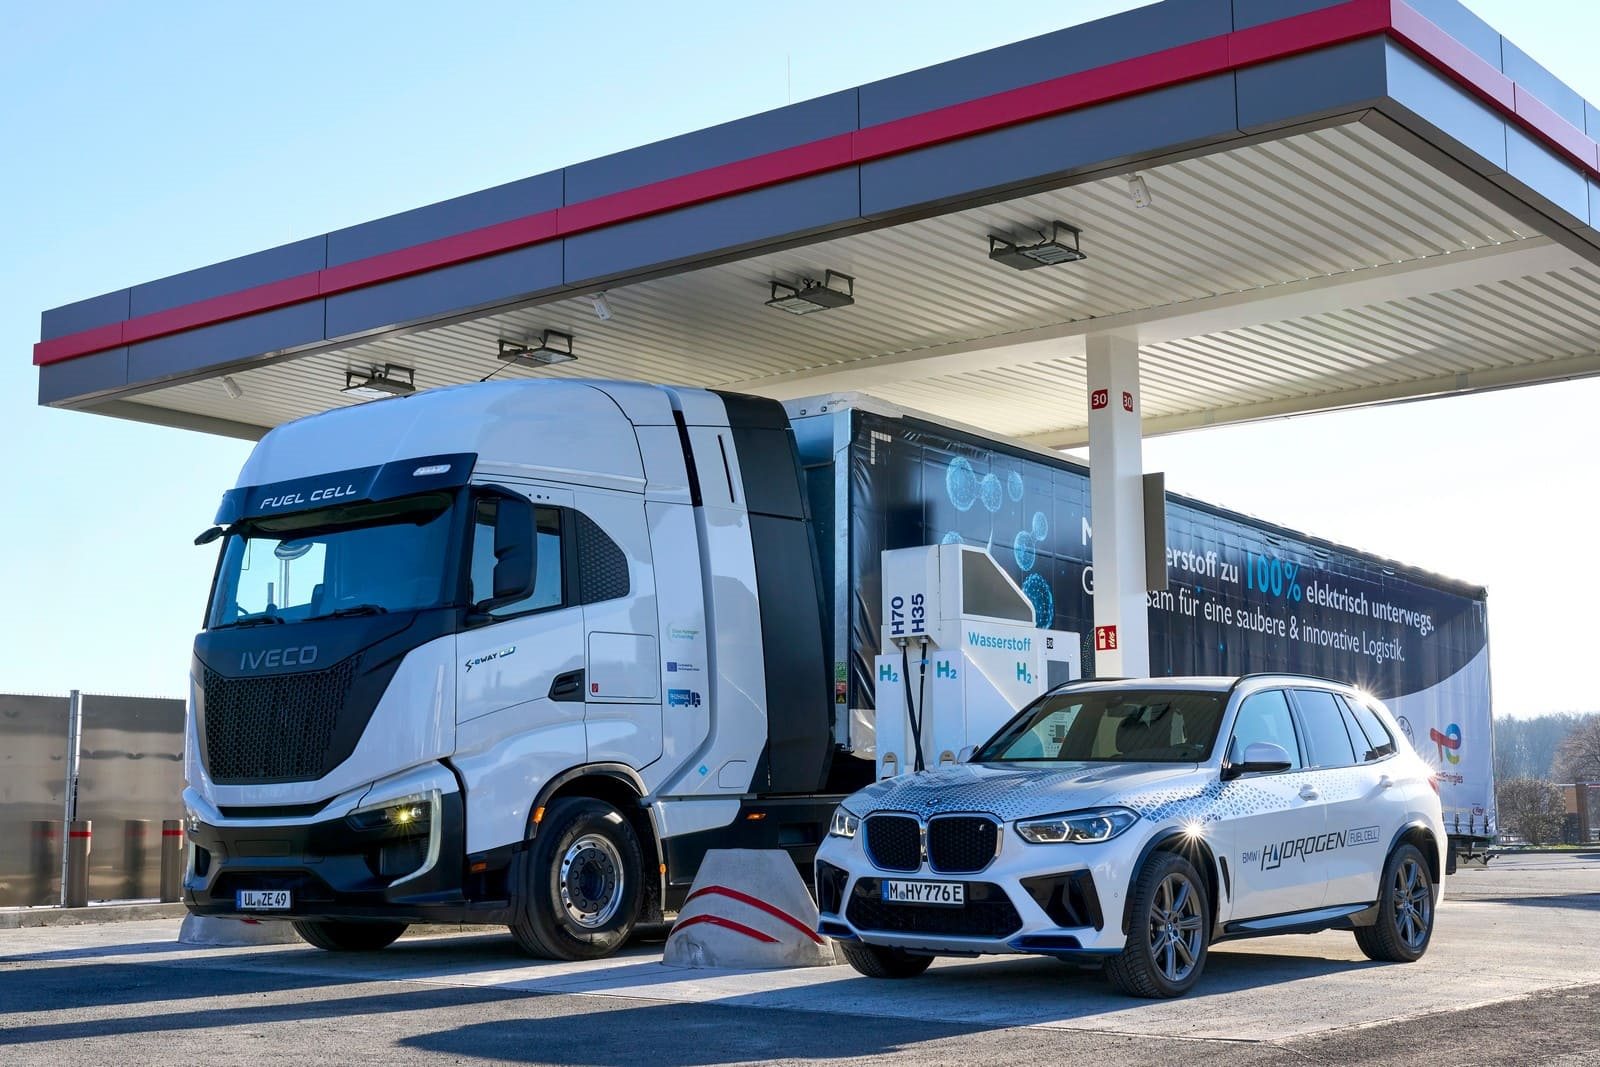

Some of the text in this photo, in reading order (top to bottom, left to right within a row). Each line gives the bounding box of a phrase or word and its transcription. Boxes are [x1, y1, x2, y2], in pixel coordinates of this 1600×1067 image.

[1093, 393, 1107, 406] 30
[260, 484, 356, 509] FUEL CELL
[1166, 547, 1434, 636] erstoff zu 100% elektrisch unterwegs.
[891, 596, 905, 635] H70
[911, 593, 925, 633] H35
[1178, 587, 1199, 617] für
[1204, 598, 1232, 625] eine
[1236, 606, 1286, 637] saubere
[1289, 615, 1299, 640] &
[1303, 619, 1359, 652] innovative
[1363, 631, 1405, 664] Logistik.
[968, 632, 1031, 651] Wasserstoff
[240, 646, 318, 670] IVECO
[1261, 829, 1347, 871] HYDROGEN
[245, 893, 255, 906] UL
[890, 883, 898, 899] M
